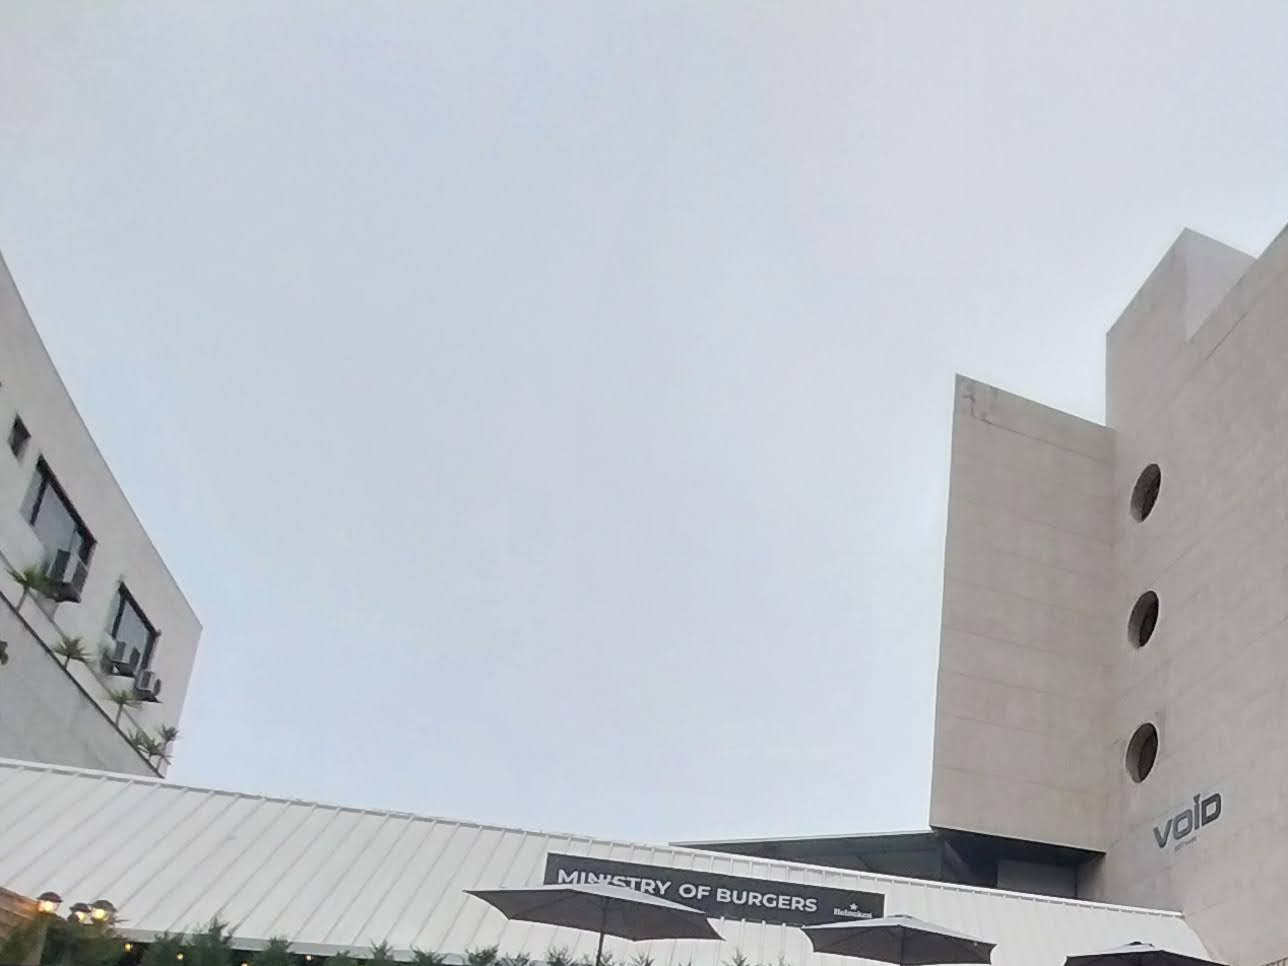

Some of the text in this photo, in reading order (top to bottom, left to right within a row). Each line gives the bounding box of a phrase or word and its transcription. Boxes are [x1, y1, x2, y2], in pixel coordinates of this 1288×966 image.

[558, 869, 818, 913] MINISTRY OF BURGERS
